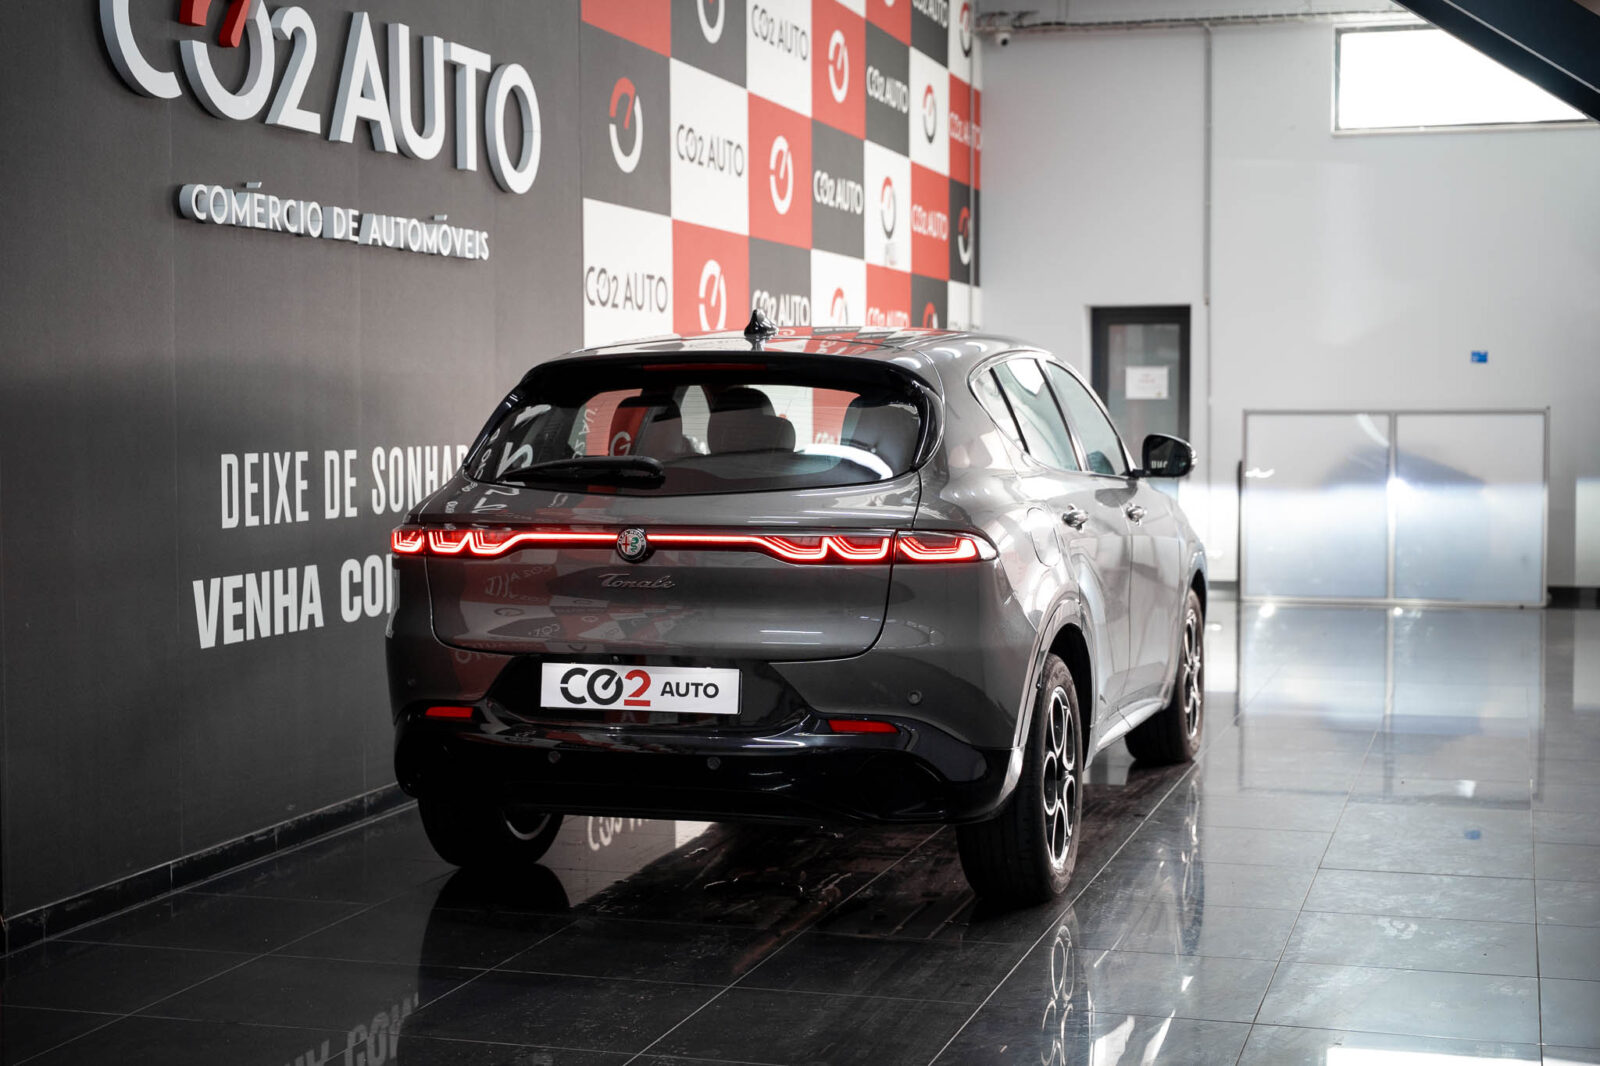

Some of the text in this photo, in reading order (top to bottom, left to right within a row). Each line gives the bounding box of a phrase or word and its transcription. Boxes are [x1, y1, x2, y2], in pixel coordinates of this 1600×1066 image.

[751, 4, 809, 61] CO2 AUTO
[329, 12, 541, 194] AUTO
[884, 76, 909, 114] AUTO
[676, 124, 745, 177] CO2 AUTO
[813, 170, 865, 215] CO2 AUTO
[179, 181, 490, 261] COMÉRCIO DE AUTOMÓVEIS
[585, 266, 669, 313] CO2 AUTO
[777, 294, 811, 327] AUTO
[220, 450, 309, 529] DEIXE
[324, 449, 358, 520] DE
[598, 573, 676, 589] Tonale
[192, 564, 324, 650] VENHA
[560, 667, 720, 707] CO2 AUTO
